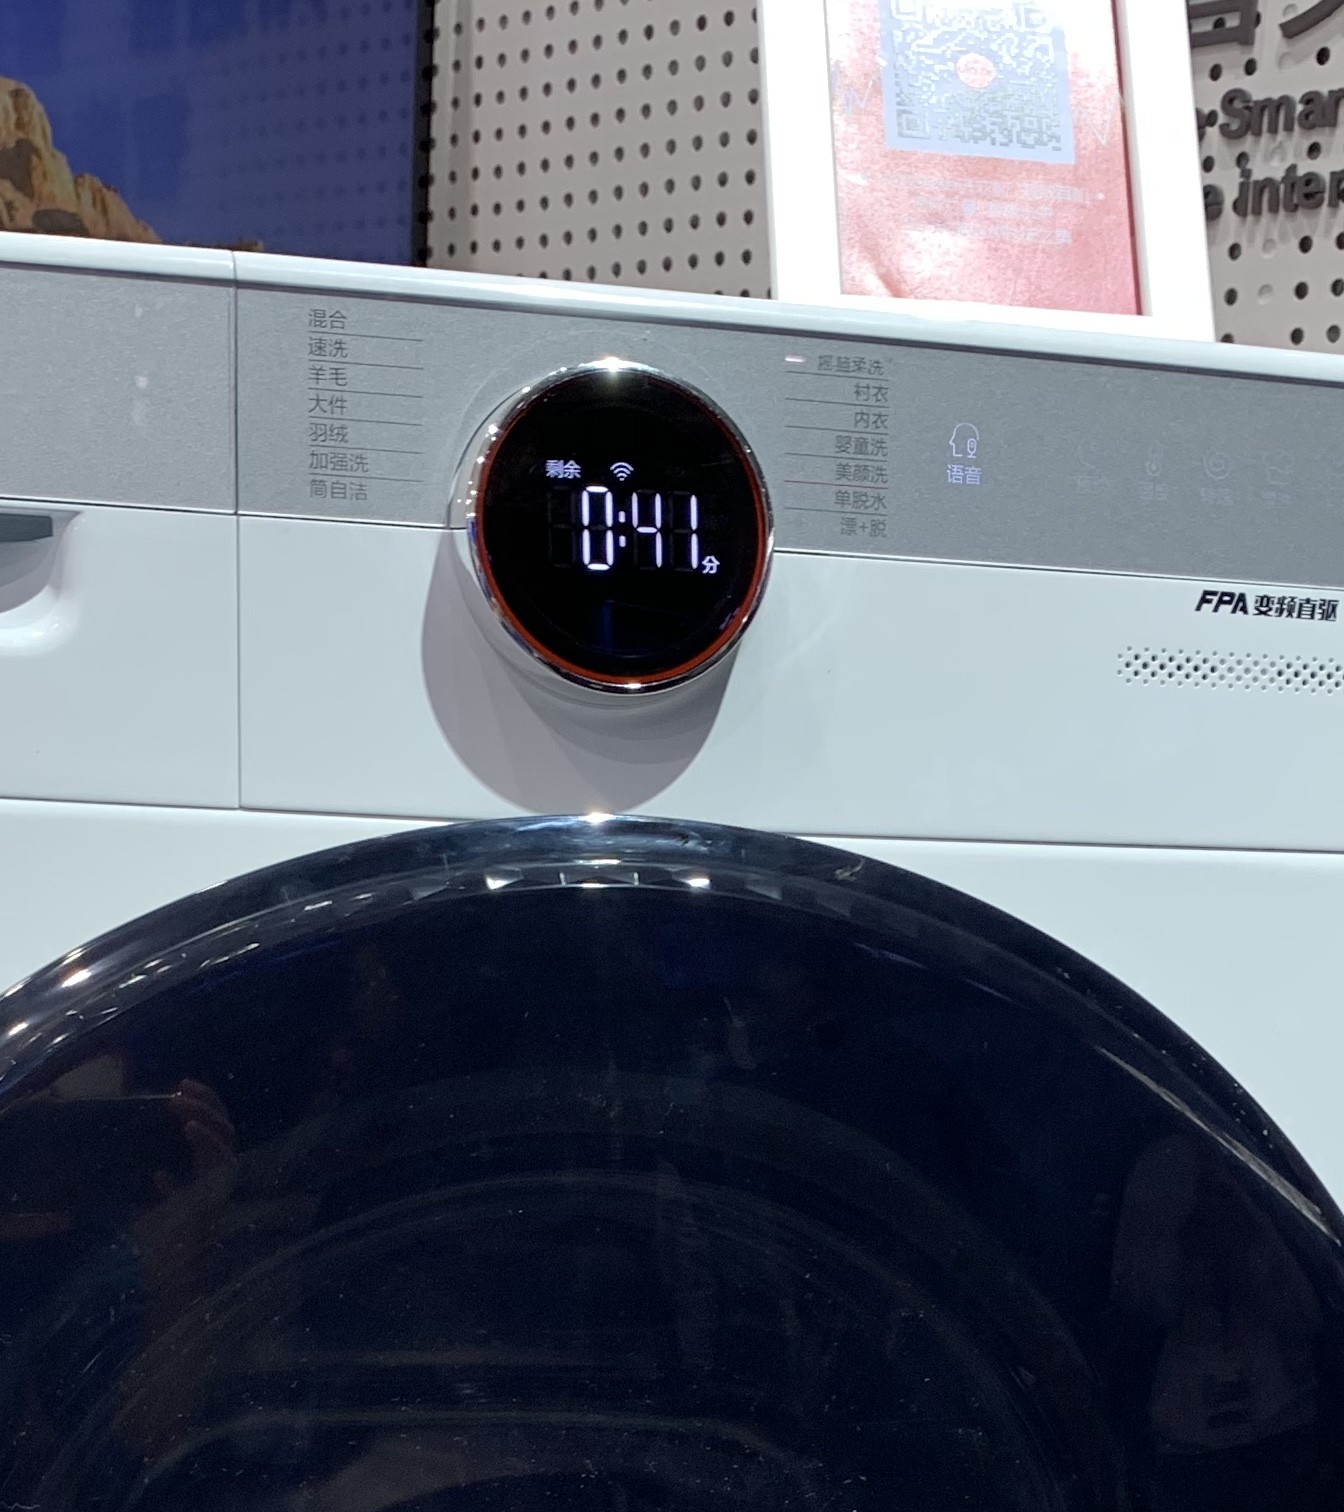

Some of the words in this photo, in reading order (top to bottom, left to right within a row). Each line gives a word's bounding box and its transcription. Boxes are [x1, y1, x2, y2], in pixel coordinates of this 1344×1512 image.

[308, 308, 348, 330] 混合
[308, 336, 348, 358] 速洗
[308, 365, 348, 387] 羊毛
[854, 383, 890, 403] 衬衣
[308, 394, 348, 416] 大件
[854, 411, 890, 431] 内衣
[309, 422, 349, 444] 羽绒
[835, 435, 889, 458] 婴童洗
[309, 452, 369, 473] 加强洗
[545, 459, 582, 479] 剩余
[835, 462, 889, 484] 美颜洗
[947, 464, 982, 485] 语音
[309, 479, 369, 501] 筒自洁
[834, 490, 889, 511] 单脱水
[581, 485, 698, 571] 0:41
[701, 555, 720, 574] 分
[1194, 589, 1249, 615] FPA
[1252, 594, 1340, 622] 变频直驱
